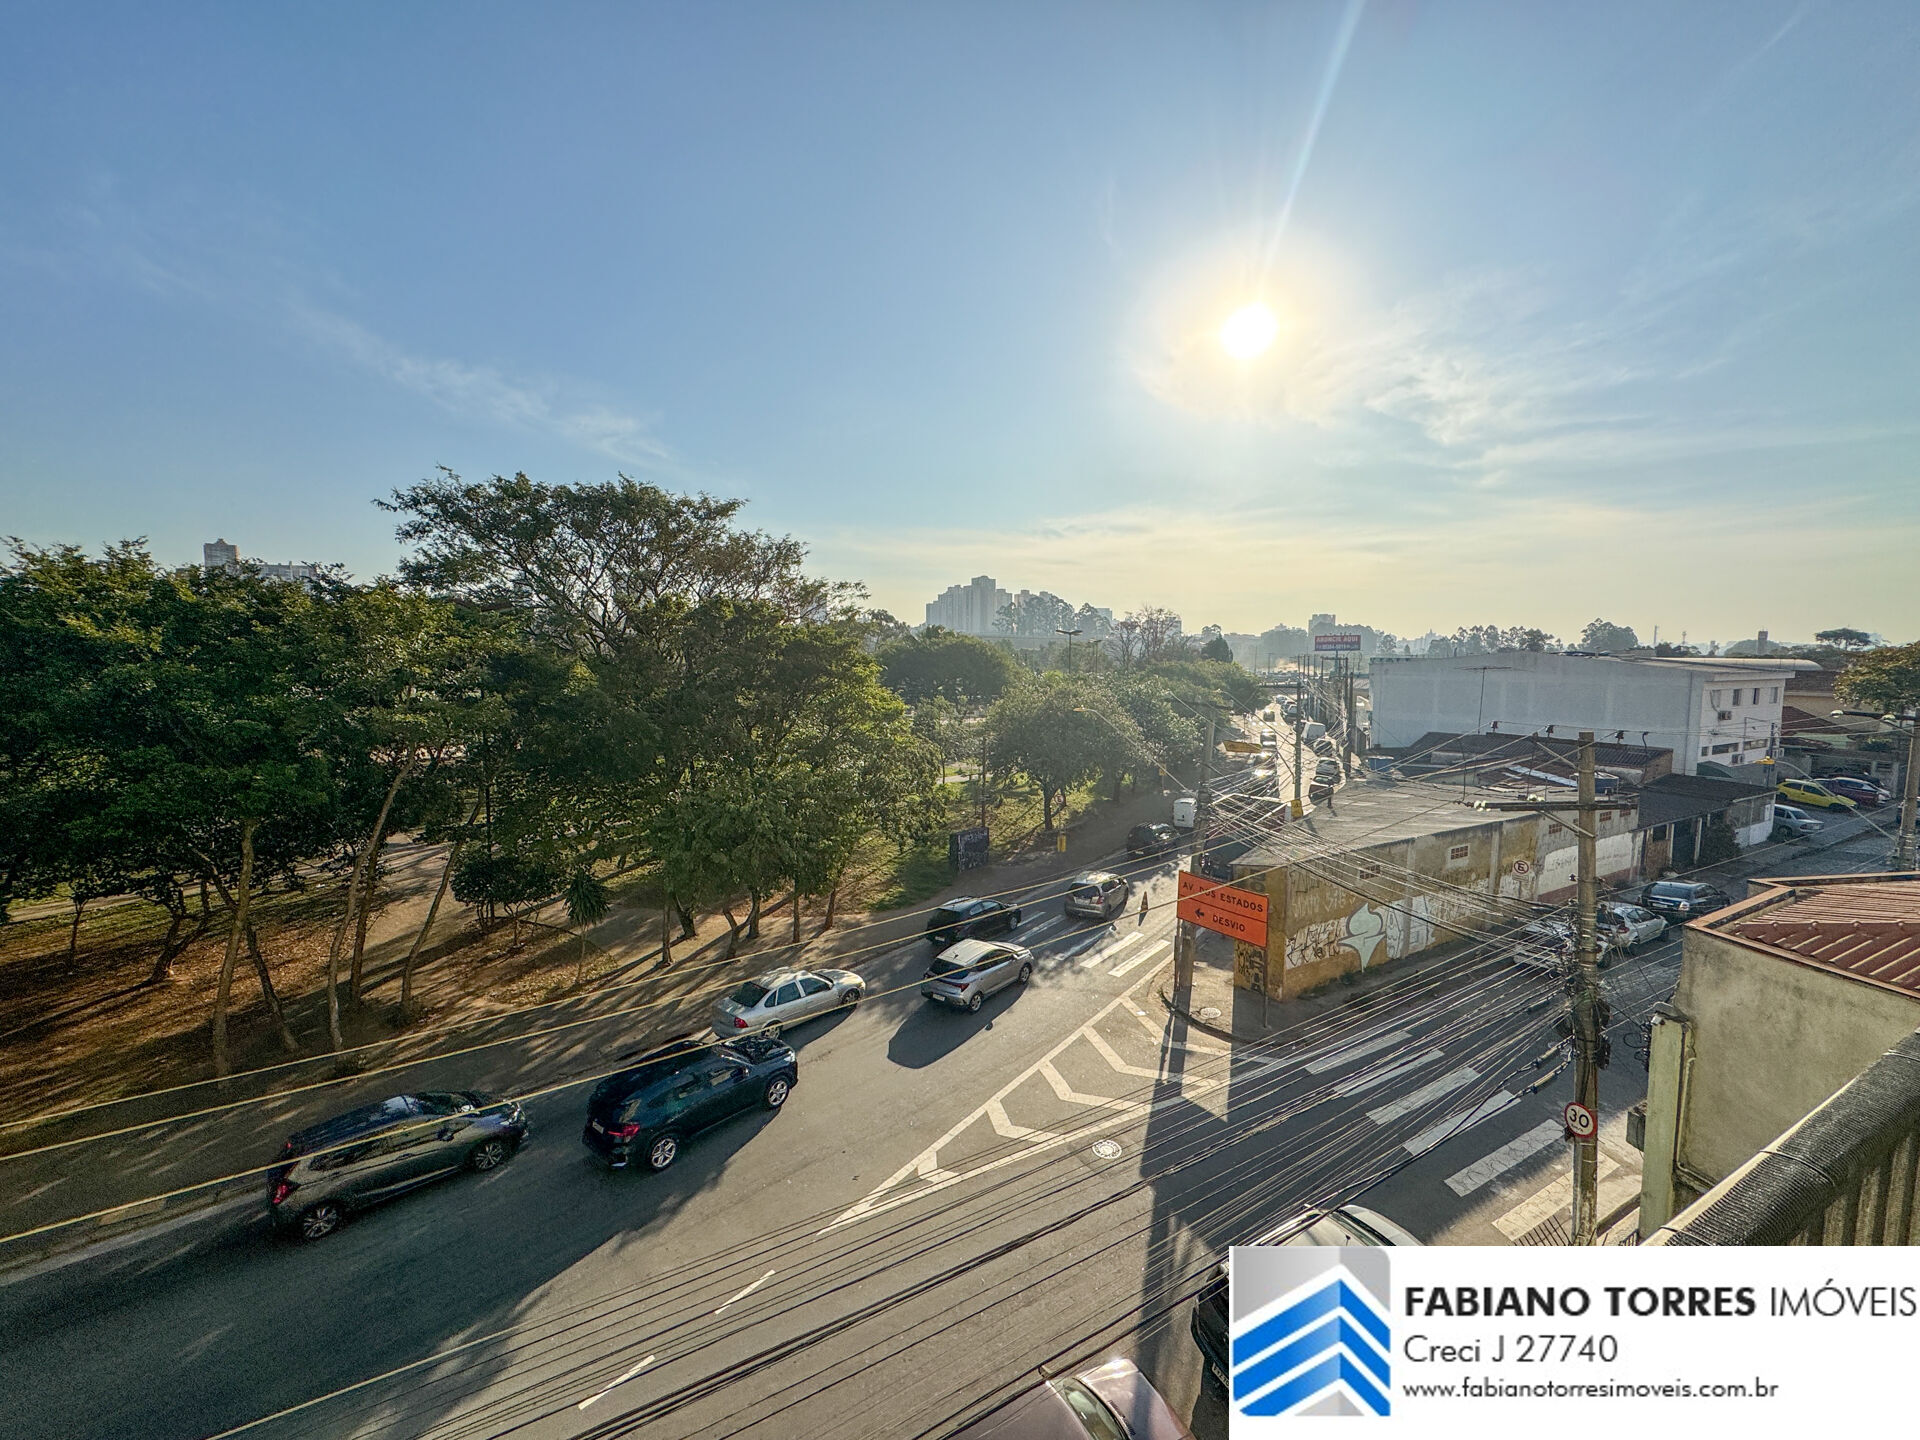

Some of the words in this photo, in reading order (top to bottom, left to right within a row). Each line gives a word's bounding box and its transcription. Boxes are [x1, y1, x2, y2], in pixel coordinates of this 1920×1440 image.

[1220, 893, 1264, 913] ESTADOS
[1212, 914, 1246, 932] DESVIO
[1569, 1108, 1590, 1128] 30
